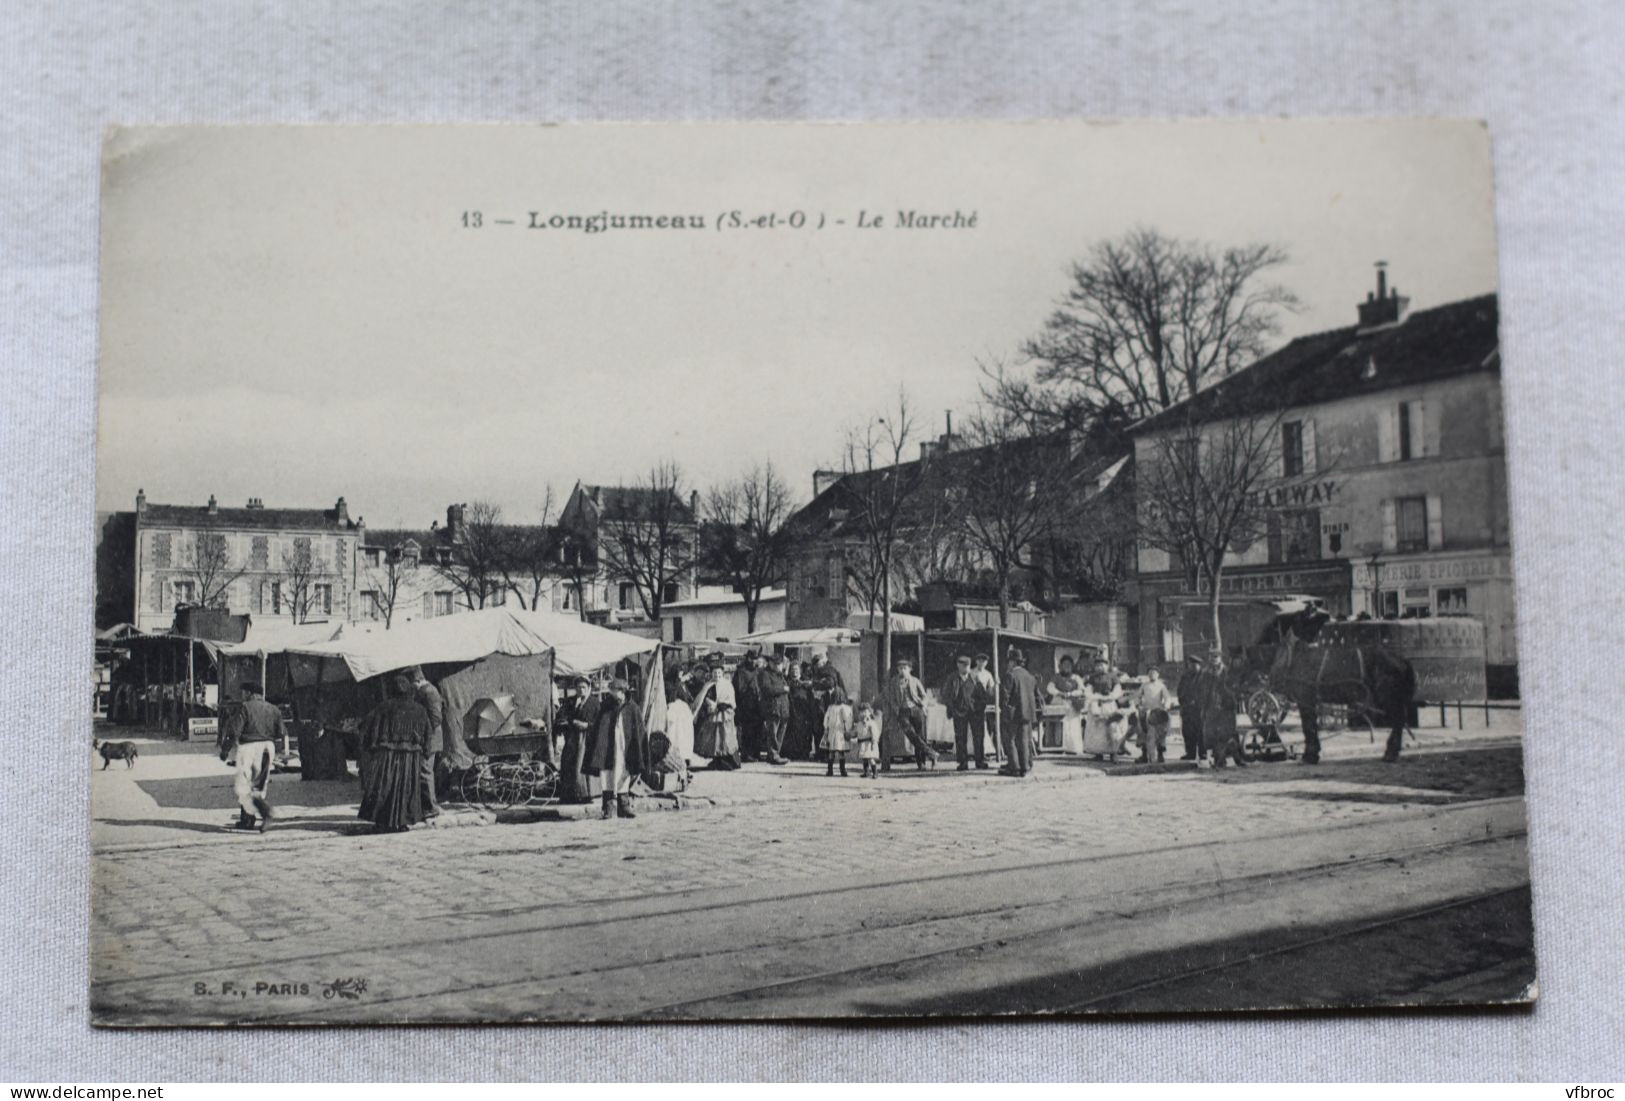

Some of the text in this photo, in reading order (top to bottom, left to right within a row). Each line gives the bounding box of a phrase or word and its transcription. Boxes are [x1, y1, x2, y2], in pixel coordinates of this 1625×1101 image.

[461, 209, 483, 229] 13
[527, 209, 707, 234] Longjumeau
[856, 209, 884, 229] Le
[895, 208, 978, 229] Marché
[255, 981, 310, 996] PARIS
